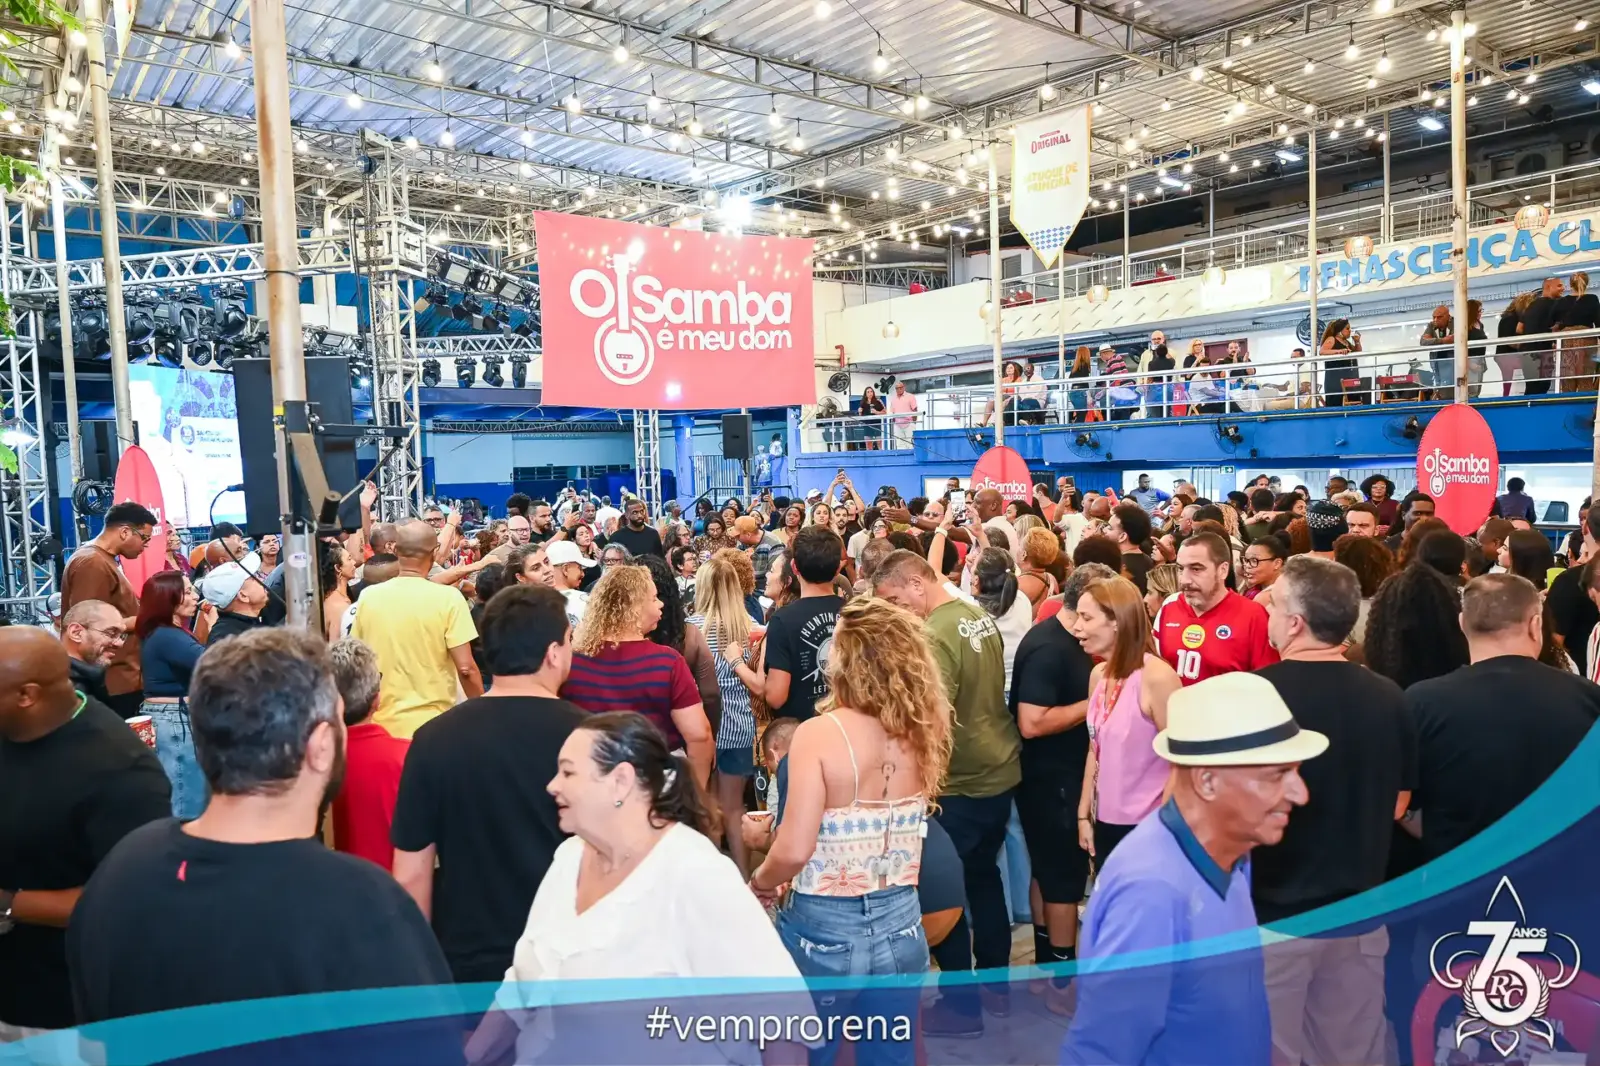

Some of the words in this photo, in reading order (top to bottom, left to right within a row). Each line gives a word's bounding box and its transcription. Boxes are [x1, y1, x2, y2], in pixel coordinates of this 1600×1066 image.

[1031, 133, 1071, 154] ORIGINAL
[632, 274, 792, 325] Samba
[656, 322, 675, 350] é
[679, 327, 735, 351] meu
[739, 323, 793, 350] dom
[1440, 454, 1489, 473] Samba
[988, 480, 1026, 493] Samba
[1446, 472, 1451, 483] é
[1452, 473, 1469, 483] meu
[1471, 473, 1489, 484] dom
[800, 612, 841, 638] HUNTING
[1176, 648, 1202, 680] 10
